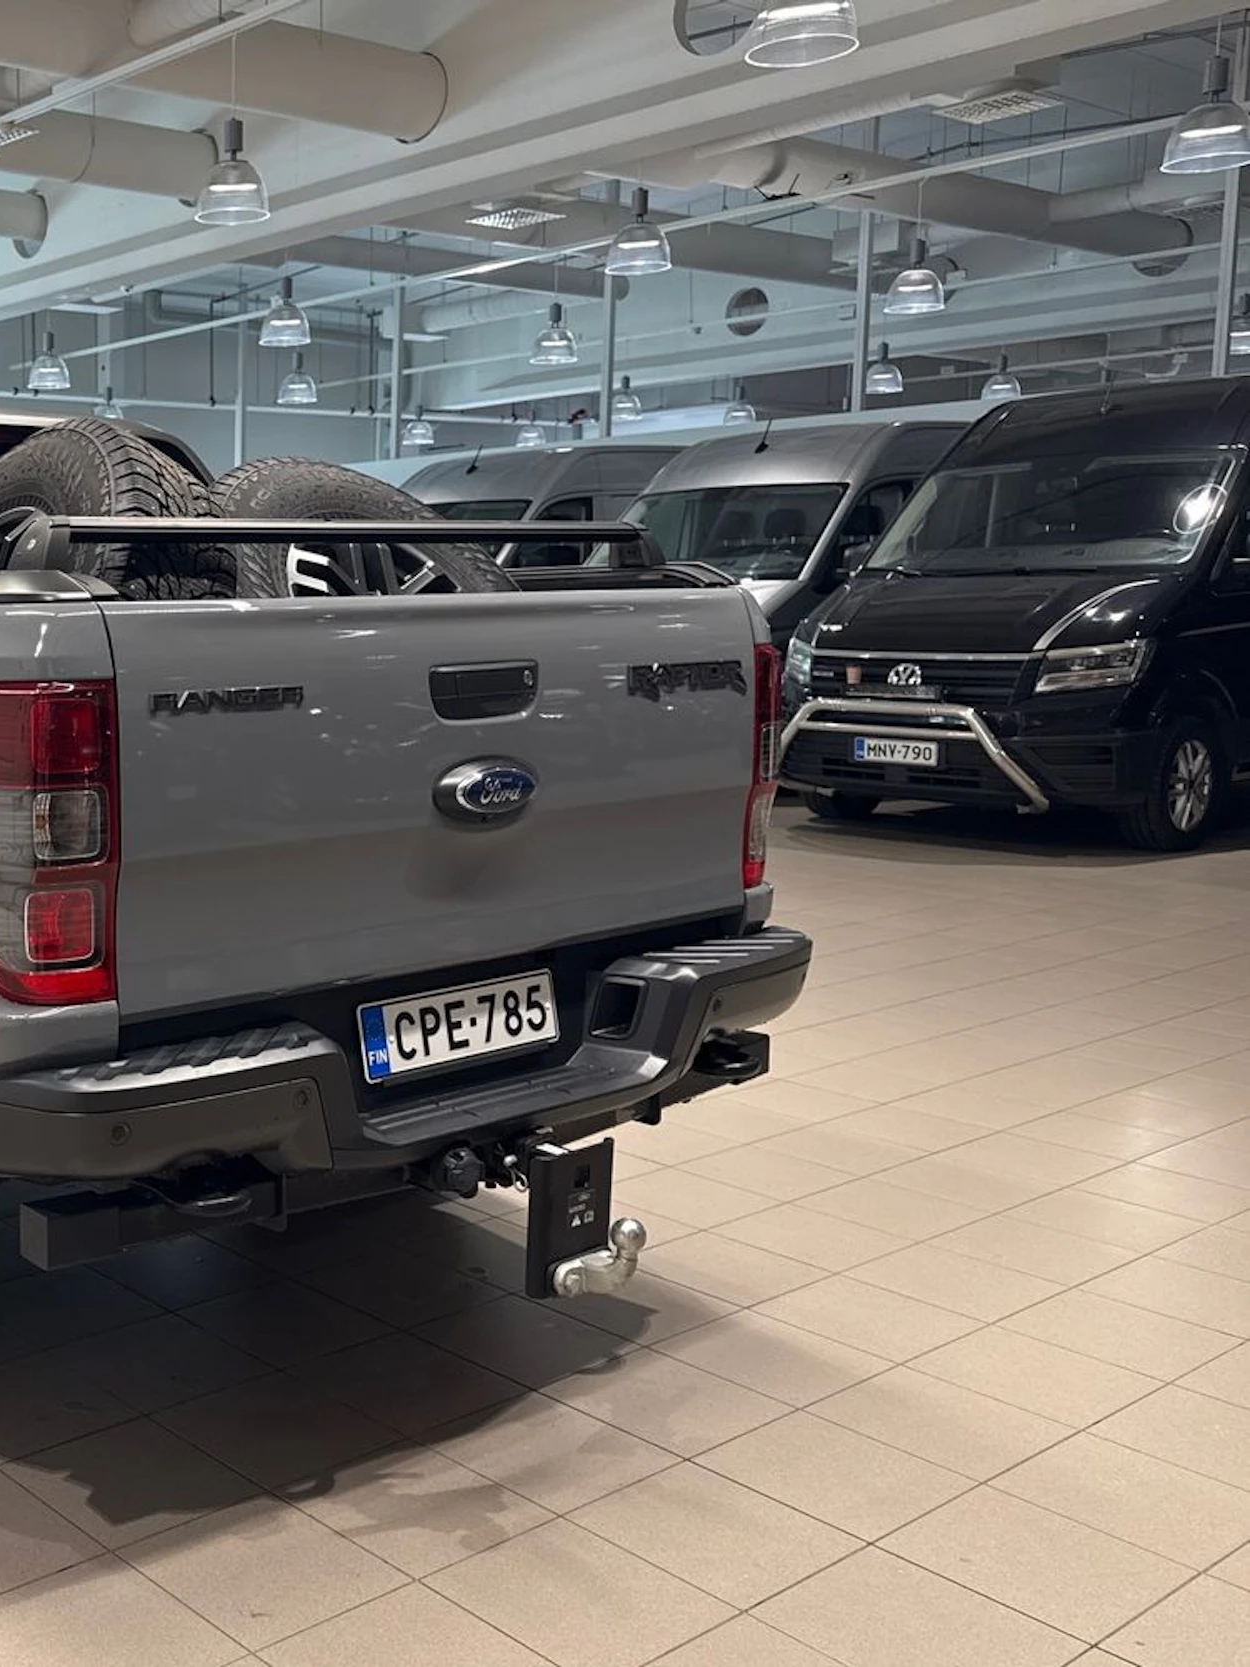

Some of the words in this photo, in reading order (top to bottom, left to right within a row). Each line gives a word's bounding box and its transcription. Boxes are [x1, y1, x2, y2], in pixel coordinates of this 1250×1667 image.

[148, 686, 304, 717] RANGER
[866, 743, 933, 761] MNV-790
[480, 777, 523, 804] Ford
[368, 1050, 388, 1067] FIN
[395, 984, 547, 1061] CPE-785
